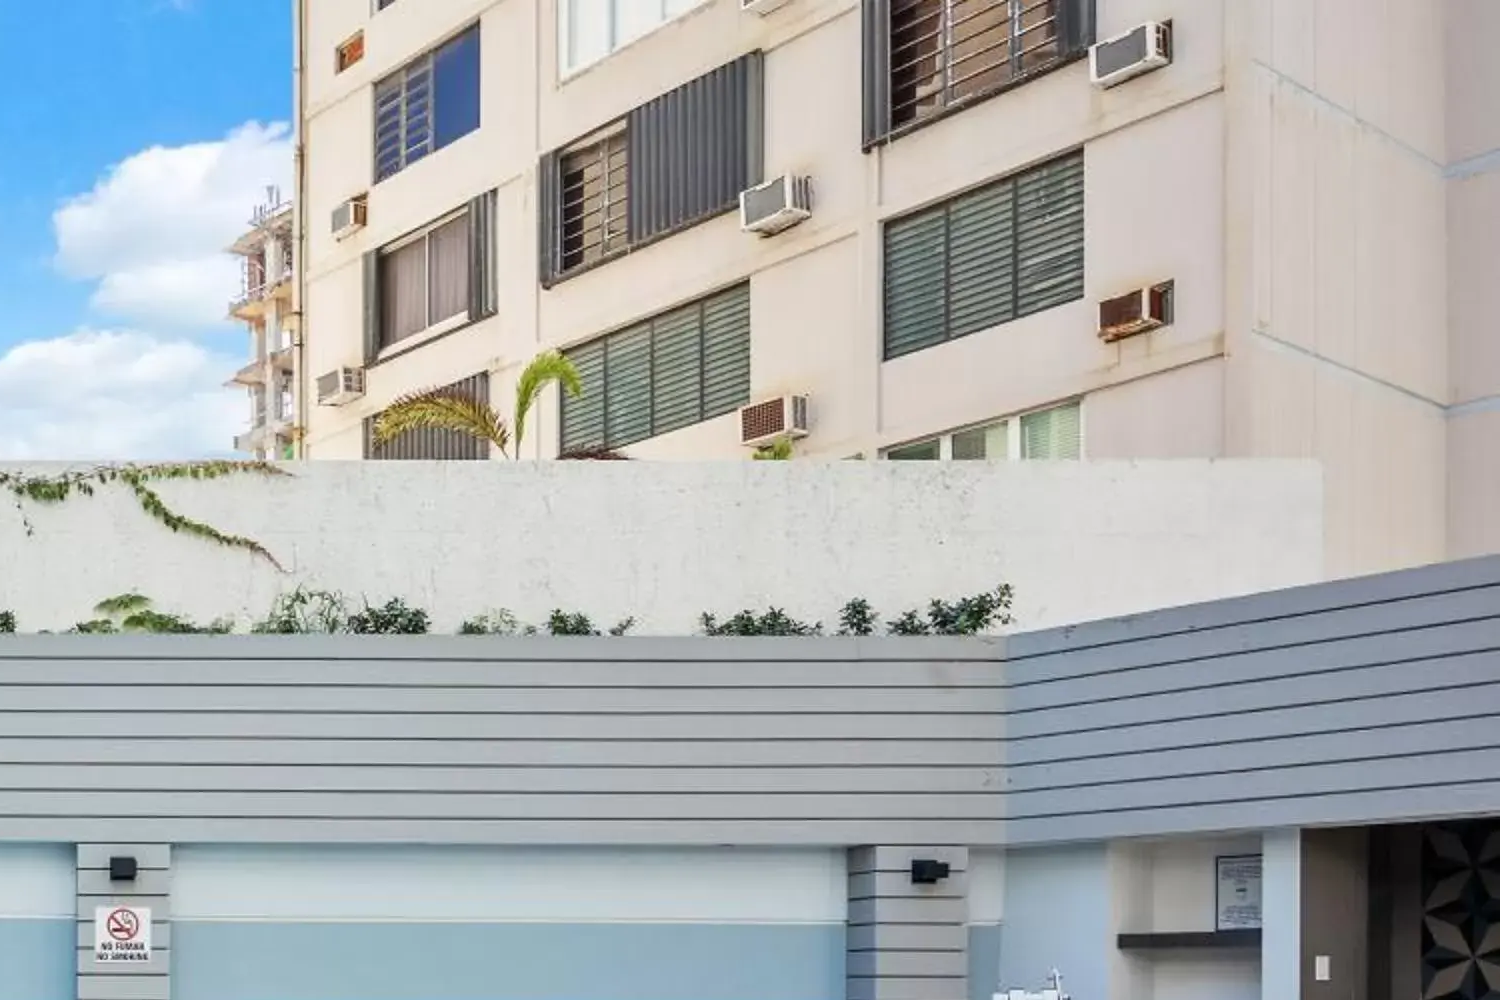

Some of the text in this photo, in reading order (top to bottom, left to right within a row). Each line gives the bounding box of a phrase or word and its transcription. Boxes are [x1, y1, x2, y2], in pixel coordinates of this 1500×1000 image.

[101, 941, 145, 950] NO FUMAR
[96, 951, 149, 960] NO SMOKING
